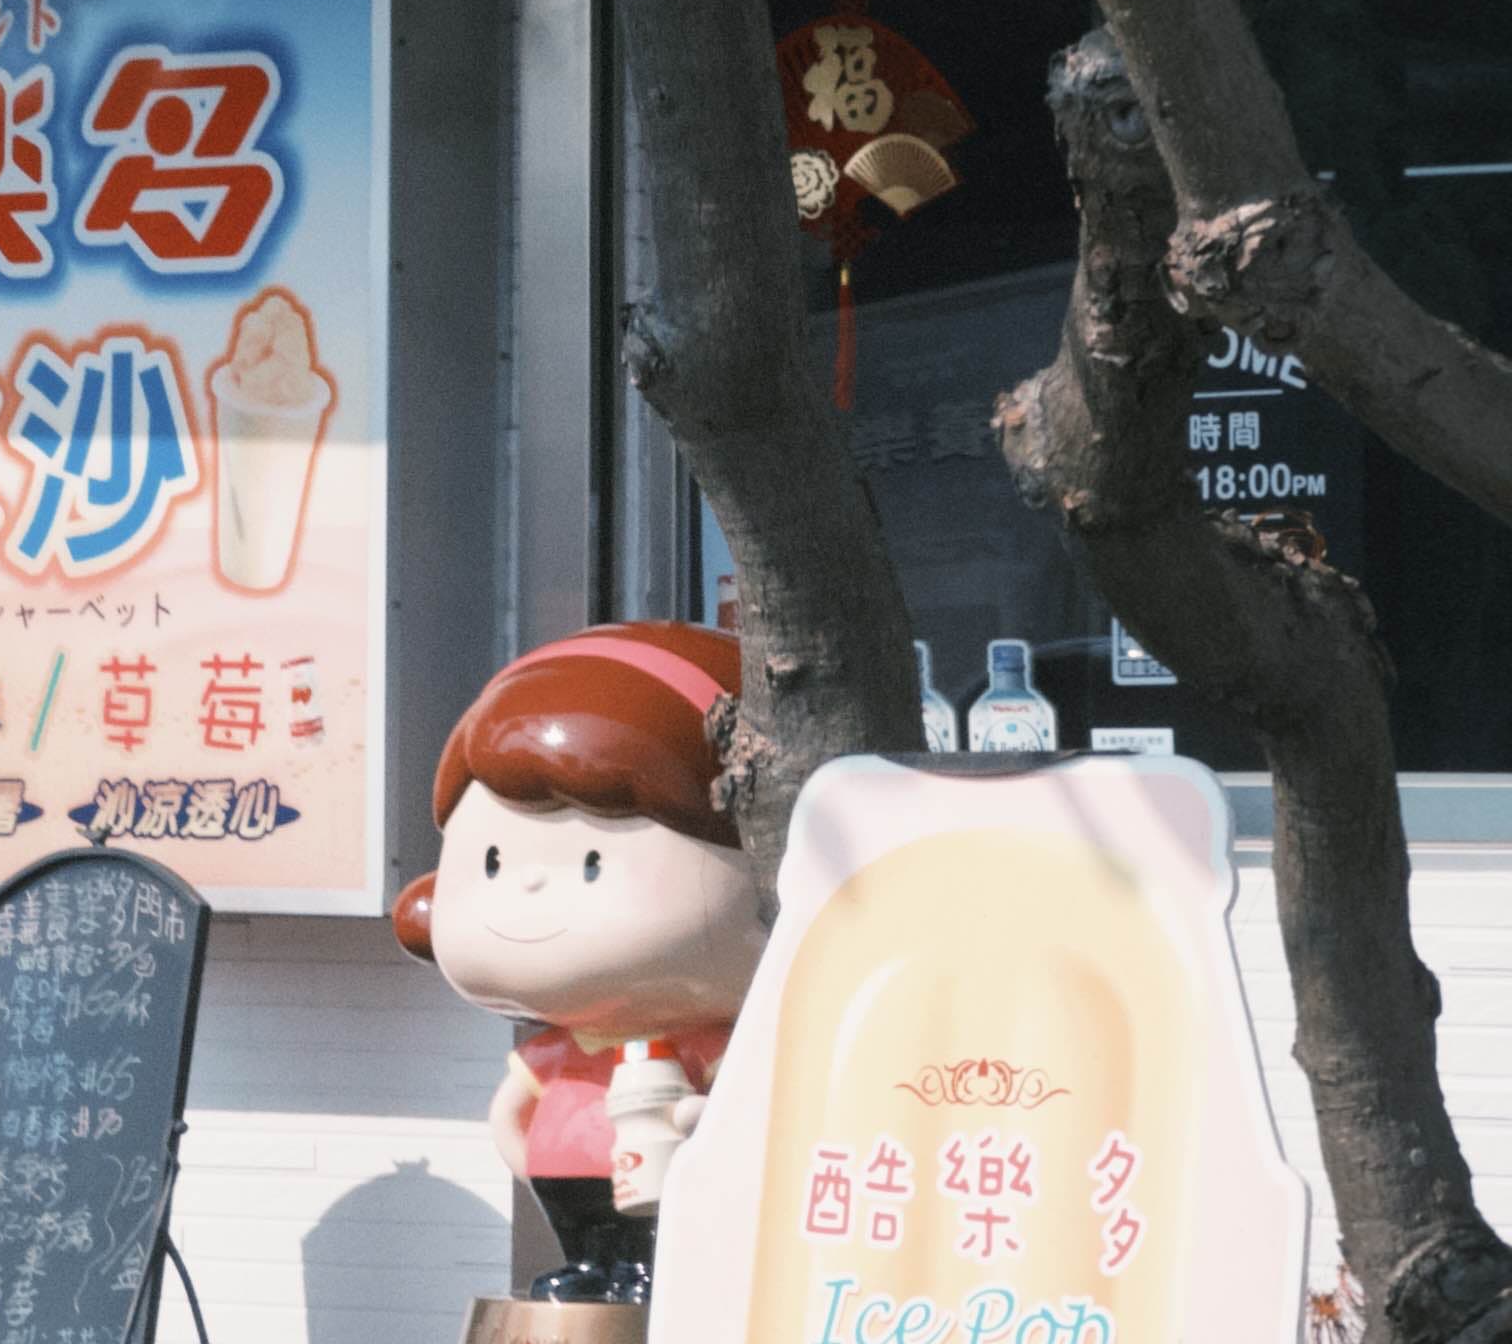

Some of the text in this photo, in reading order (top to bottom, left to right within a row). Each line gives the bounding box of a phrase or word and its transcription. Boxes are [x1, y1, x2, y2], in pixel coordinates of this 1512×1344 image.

[803, 25, 894, 133] 福
[1188, 411, 1260, 451] 時間
[805, 1135, 1141, 1268] 酷樂多
